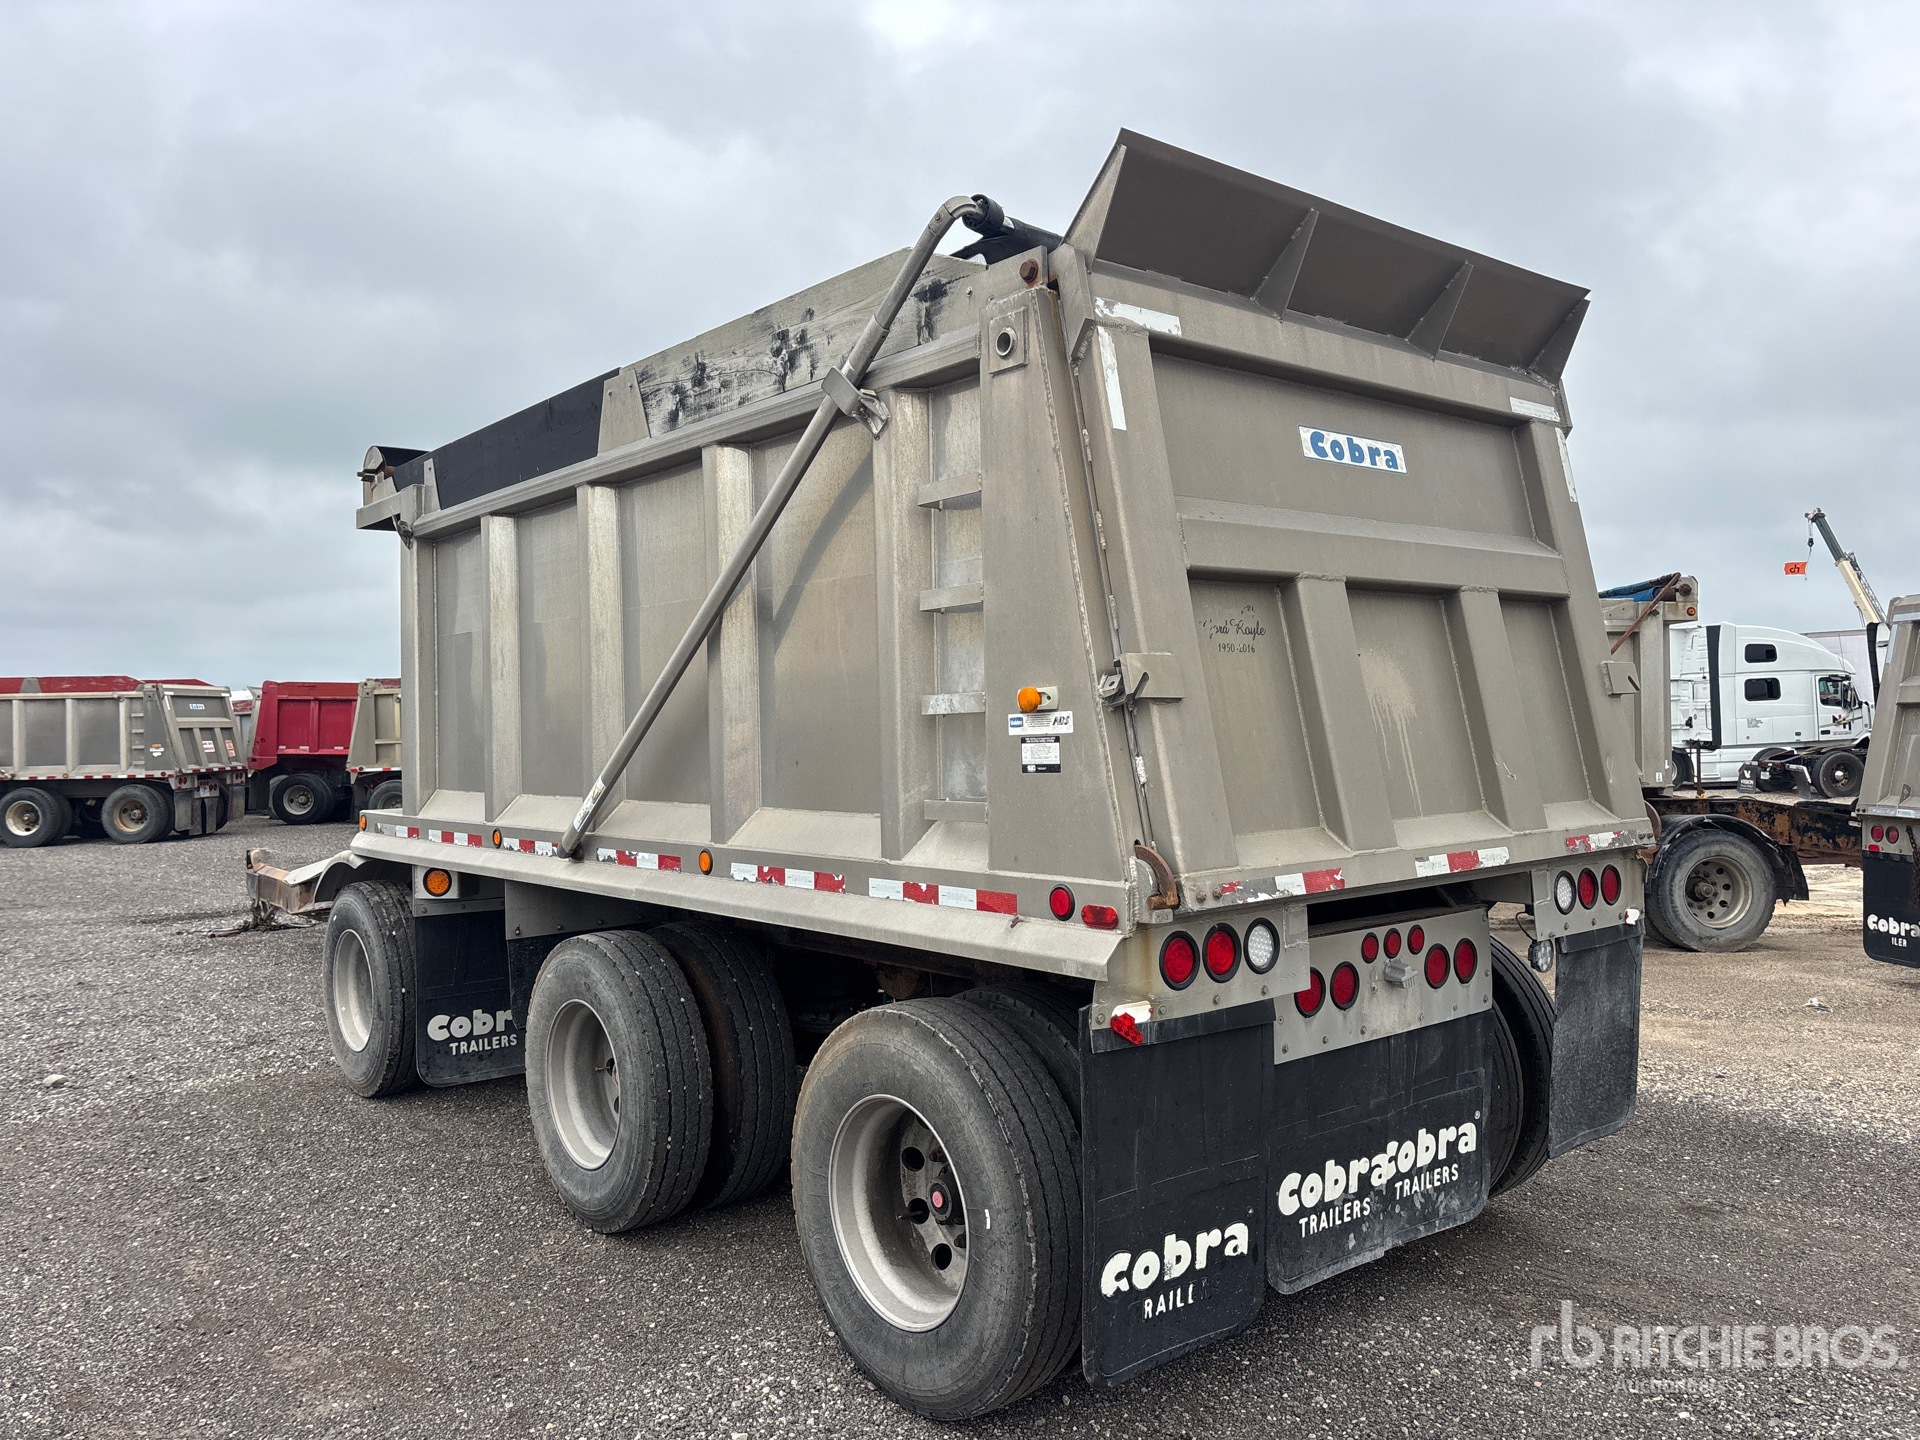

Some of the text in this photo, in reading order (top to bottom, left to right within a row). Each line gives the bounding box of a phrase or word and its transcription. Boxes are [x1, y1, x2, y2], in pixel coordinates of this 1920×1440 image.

[1309, 431, 1399, 470] Cobra
[1891, 936, 1907, 947] ILER
[427, 1009, 513, 1041] Cobr
[449, 1034, 517, 1055] TRAILERS
[1278, 1153, 1389, 1216] Cobra
[1299, 1163, 1459, 1238] TRAILERS TRAILERS
[1100, 1222, 1249, 1298] Cobra
